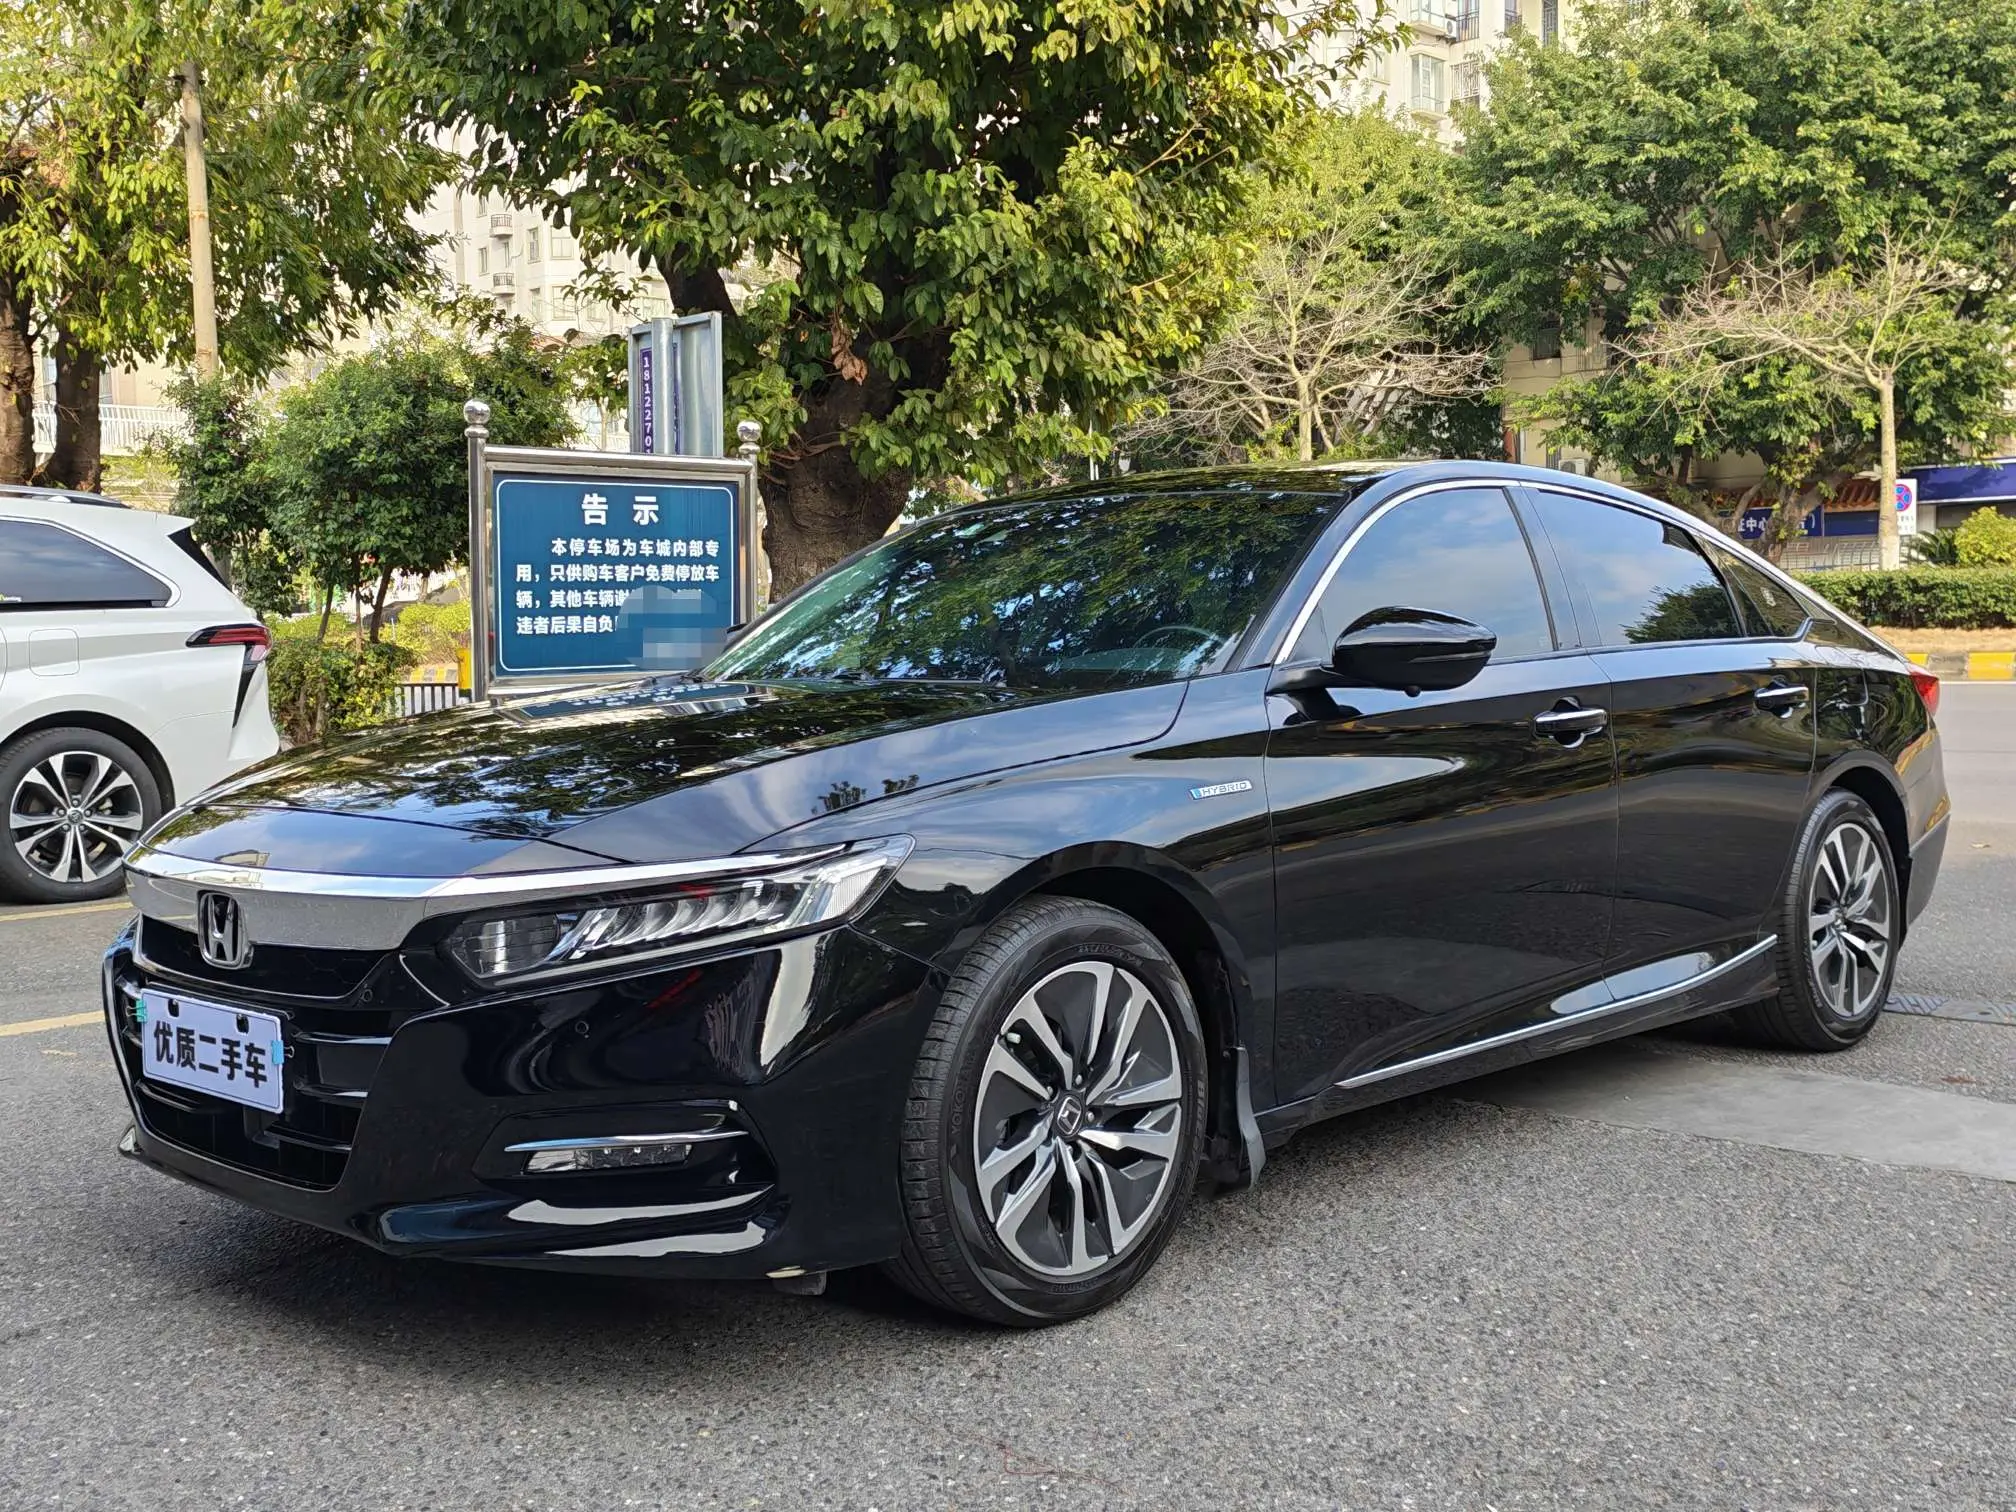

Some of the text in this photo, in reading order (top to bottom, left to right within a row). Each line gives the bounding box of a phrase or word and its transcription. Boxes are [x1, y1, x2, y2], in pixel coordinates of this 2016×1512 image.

[581, 493, 660, 525] 告示
[551, 537, 720, 558] 本停车场为车城内部专
[515, 563, 720, 583] 用，只供购车客户免费停放车
[1201, 781, 1248, 796] HYBRID
[153, 1020, 268, 1089] 优质二手车
